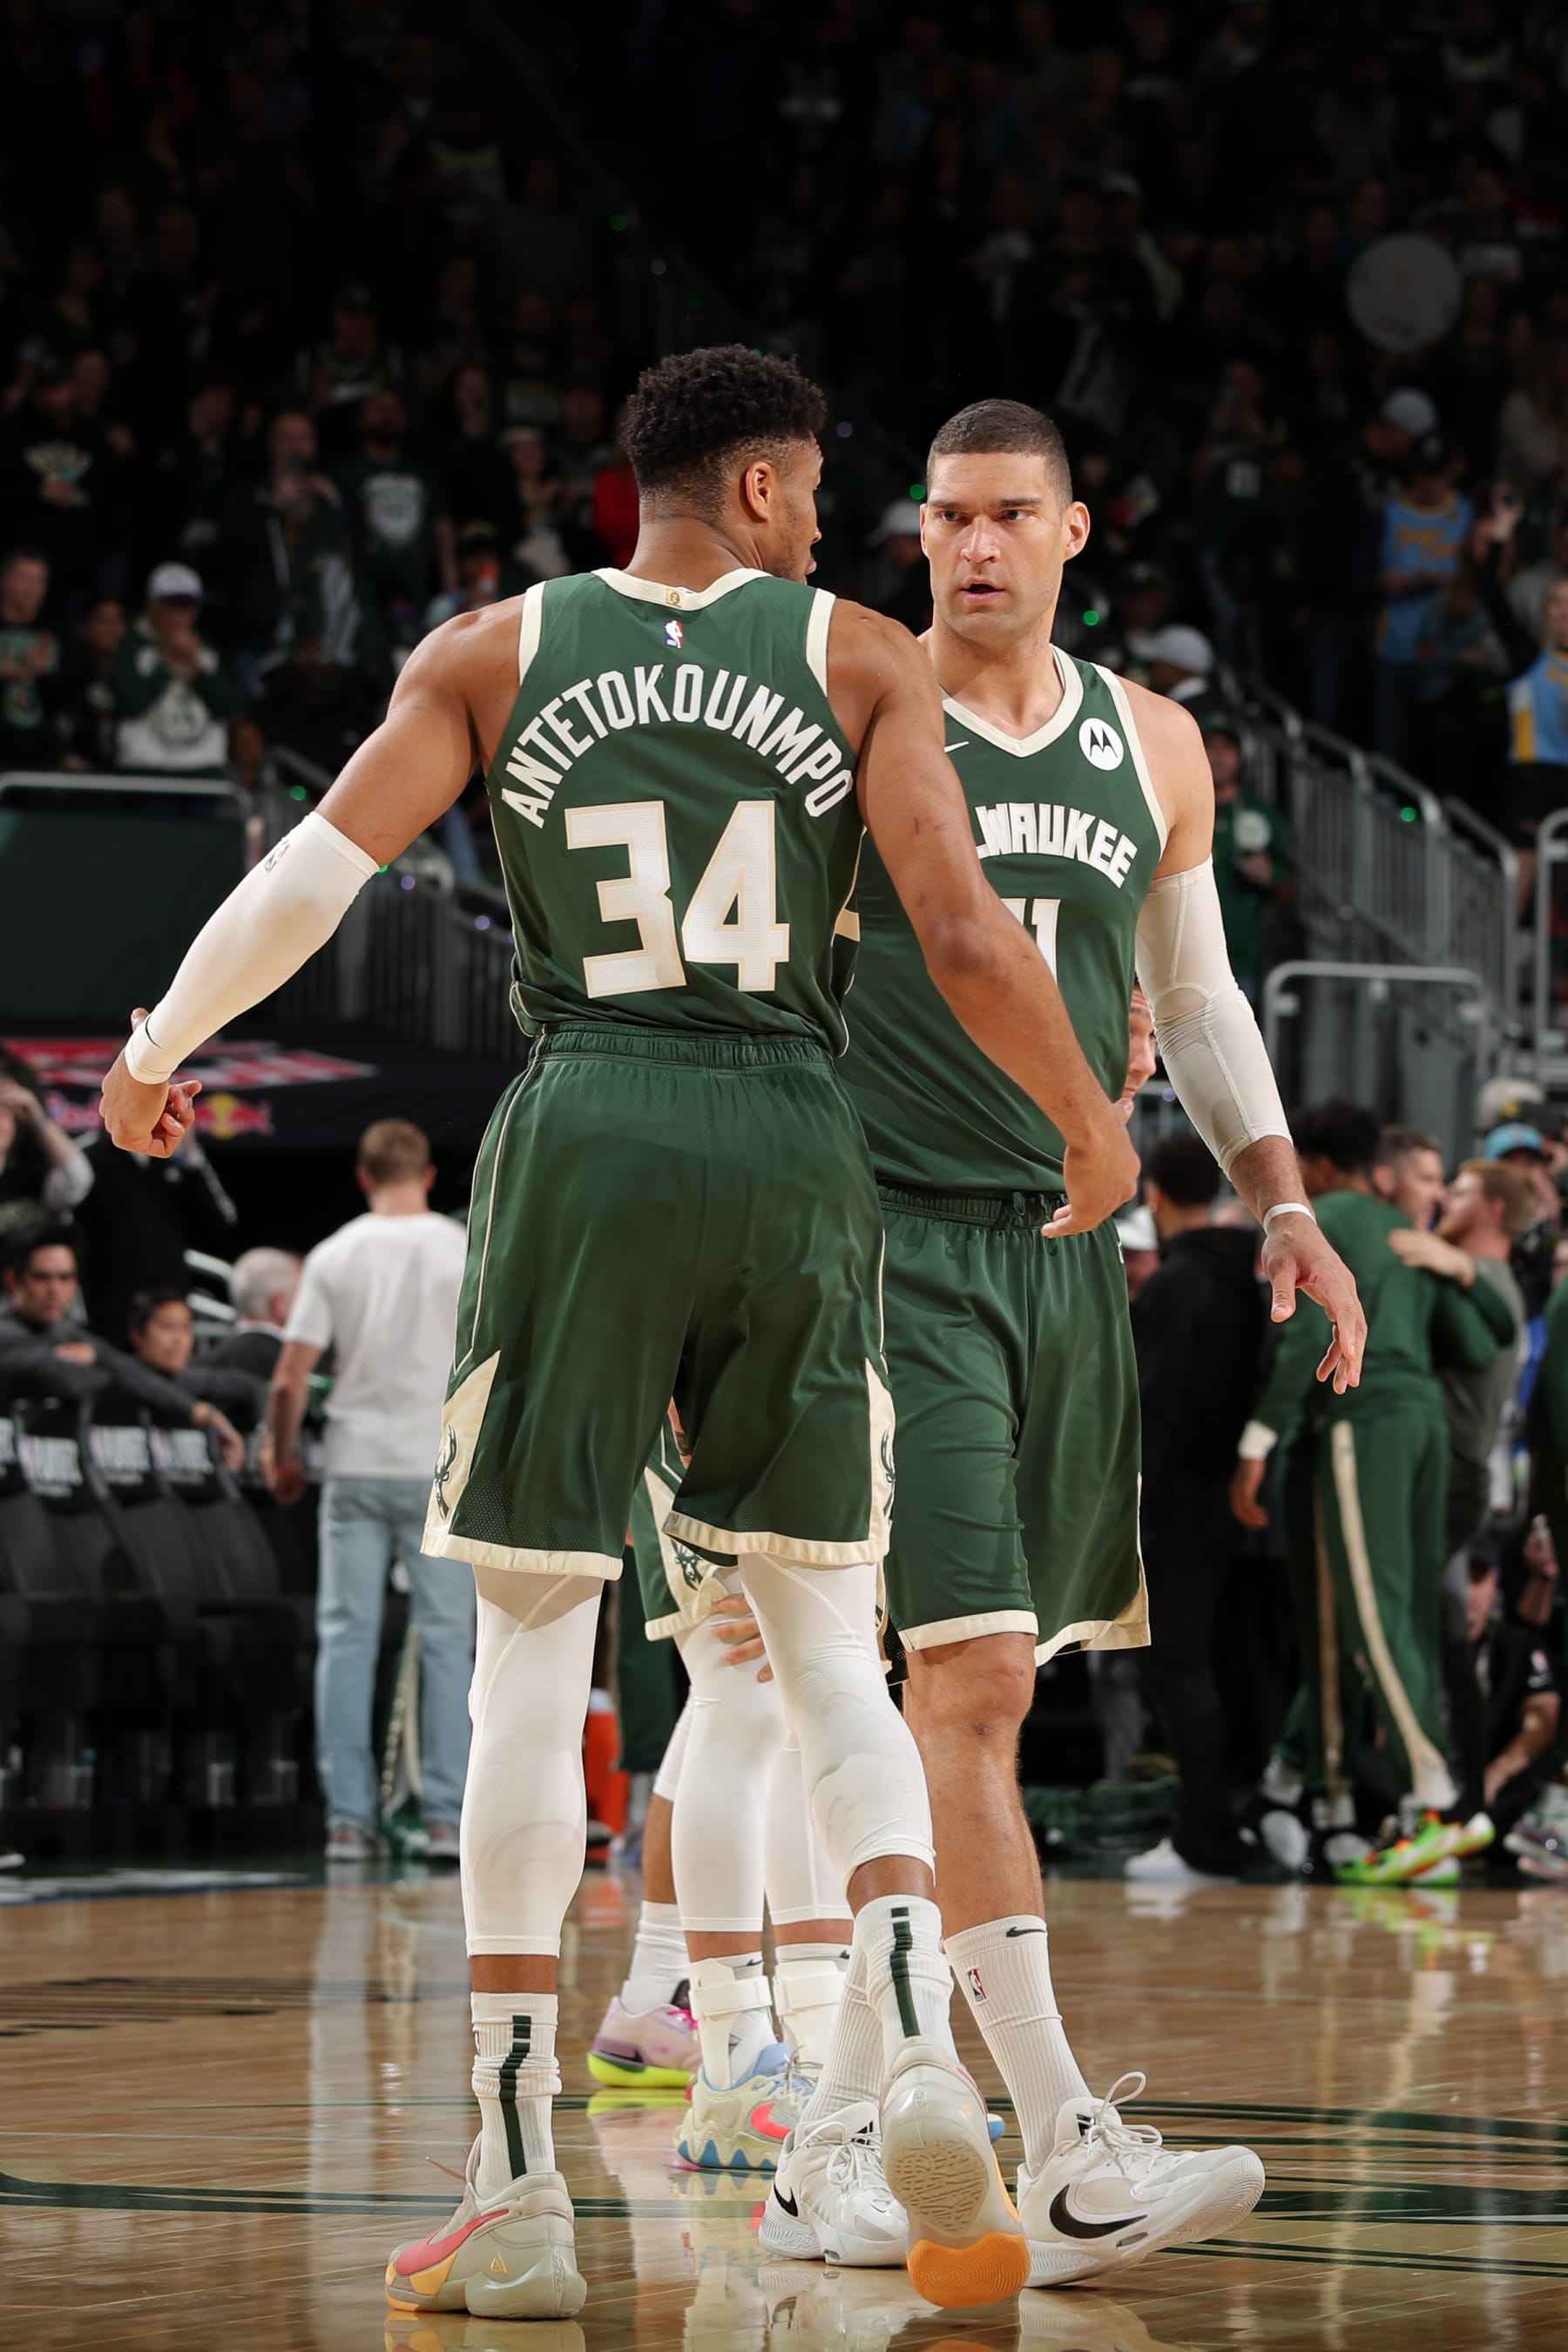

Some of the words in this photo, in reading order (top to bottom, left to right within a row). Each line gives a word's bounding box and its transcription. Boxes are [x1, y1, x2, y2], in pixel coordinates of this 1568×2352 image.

[501, 663, 853, 828] ANTETOKOUNMPO
[564, 800, 790, 998] 34
[975, 802, 1138, 889] WAUKEE
